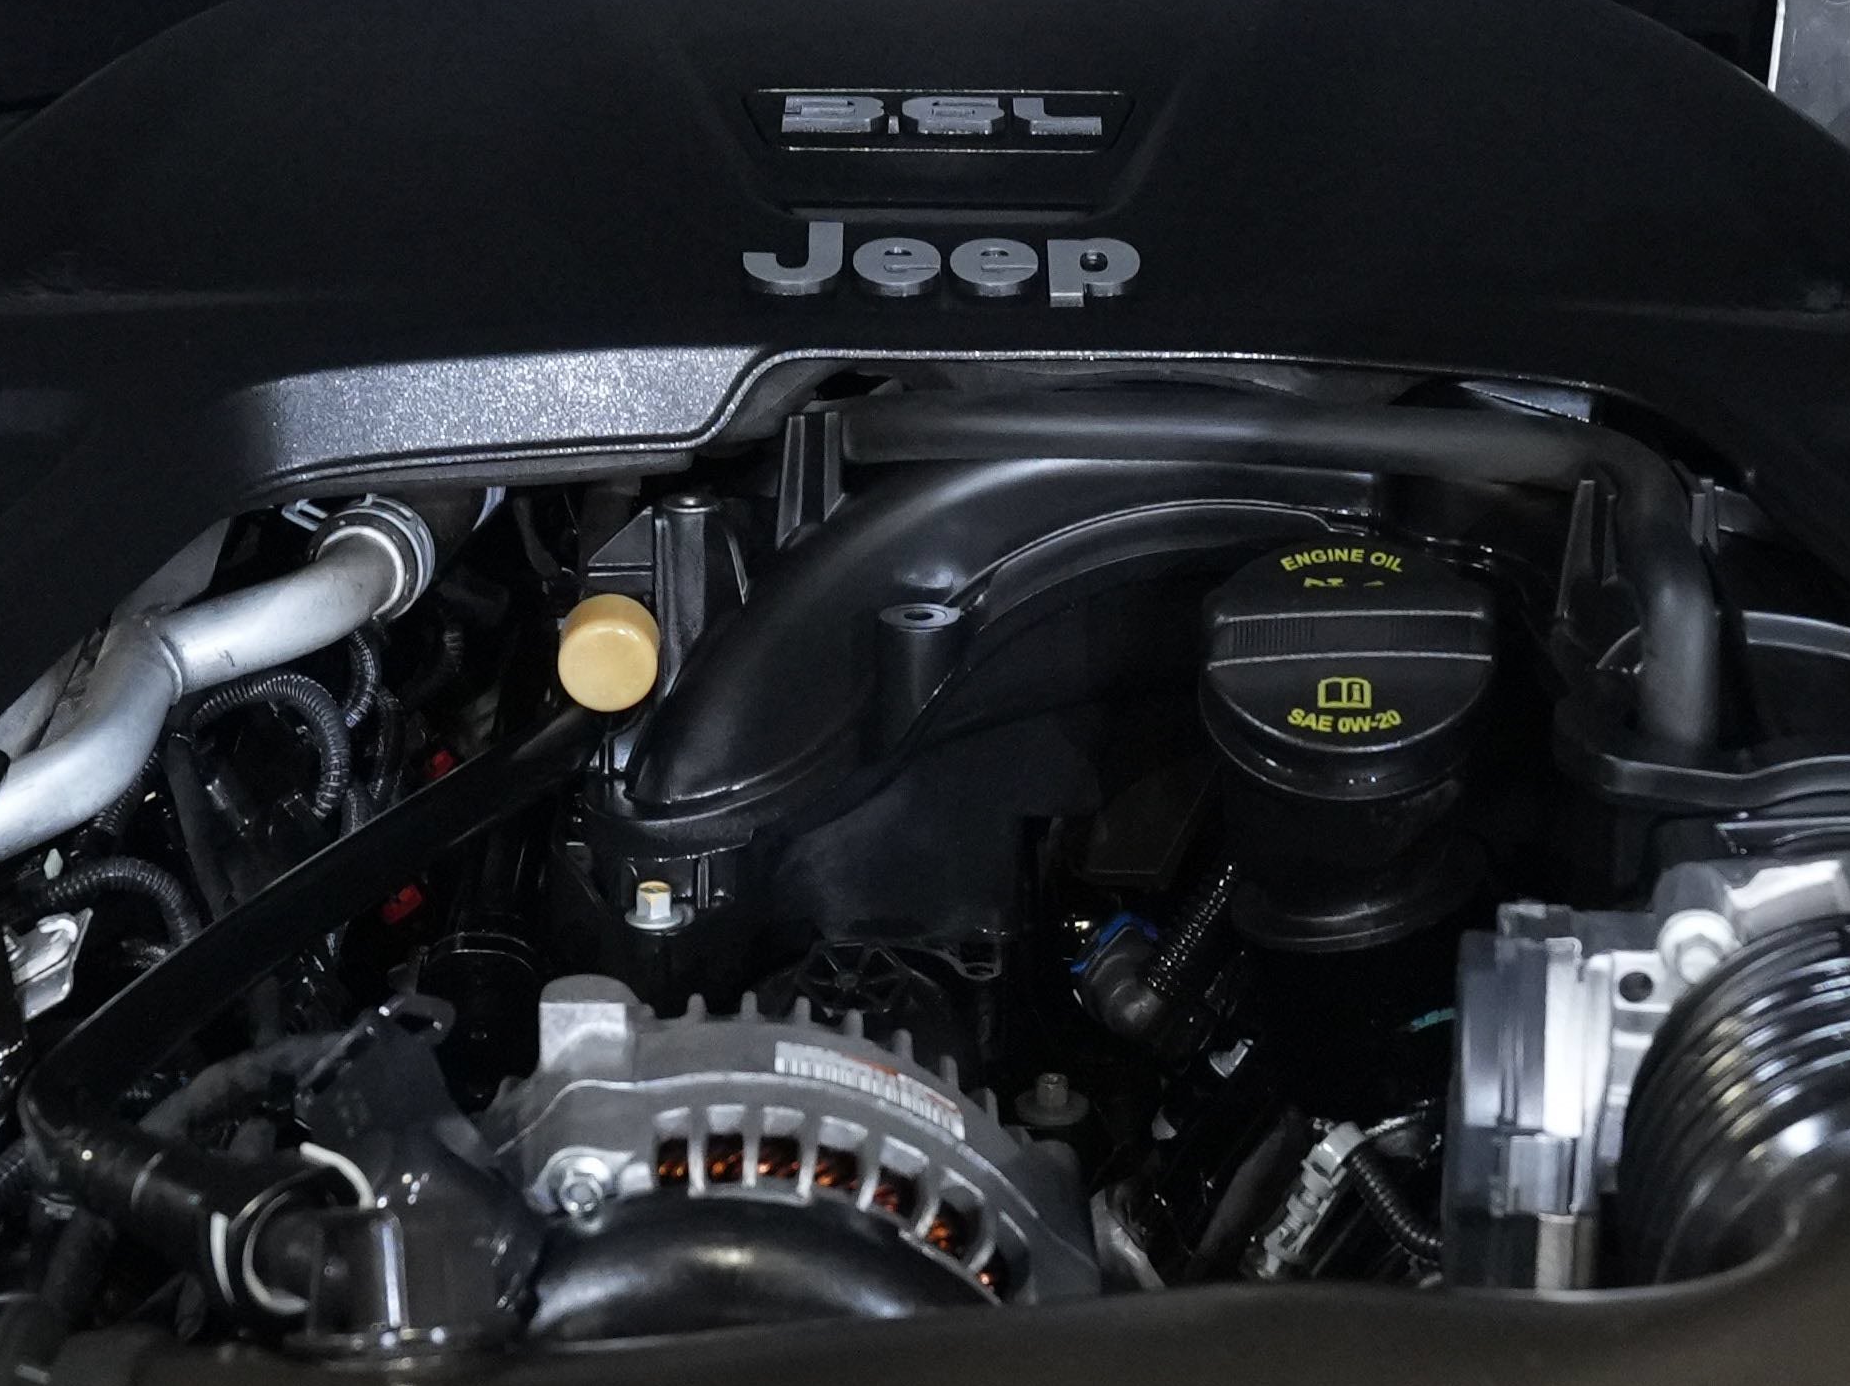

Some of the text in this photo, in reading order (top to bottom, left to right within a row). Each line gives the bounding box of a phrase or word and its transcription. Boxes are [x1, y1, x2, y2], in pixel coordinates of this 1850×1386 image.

[742, 221, 1141, 308] Jeep
[1279, 548, 1404, 573] ENGINE OIL
[1286, 707, 1402, 734] SAE 0W-20
